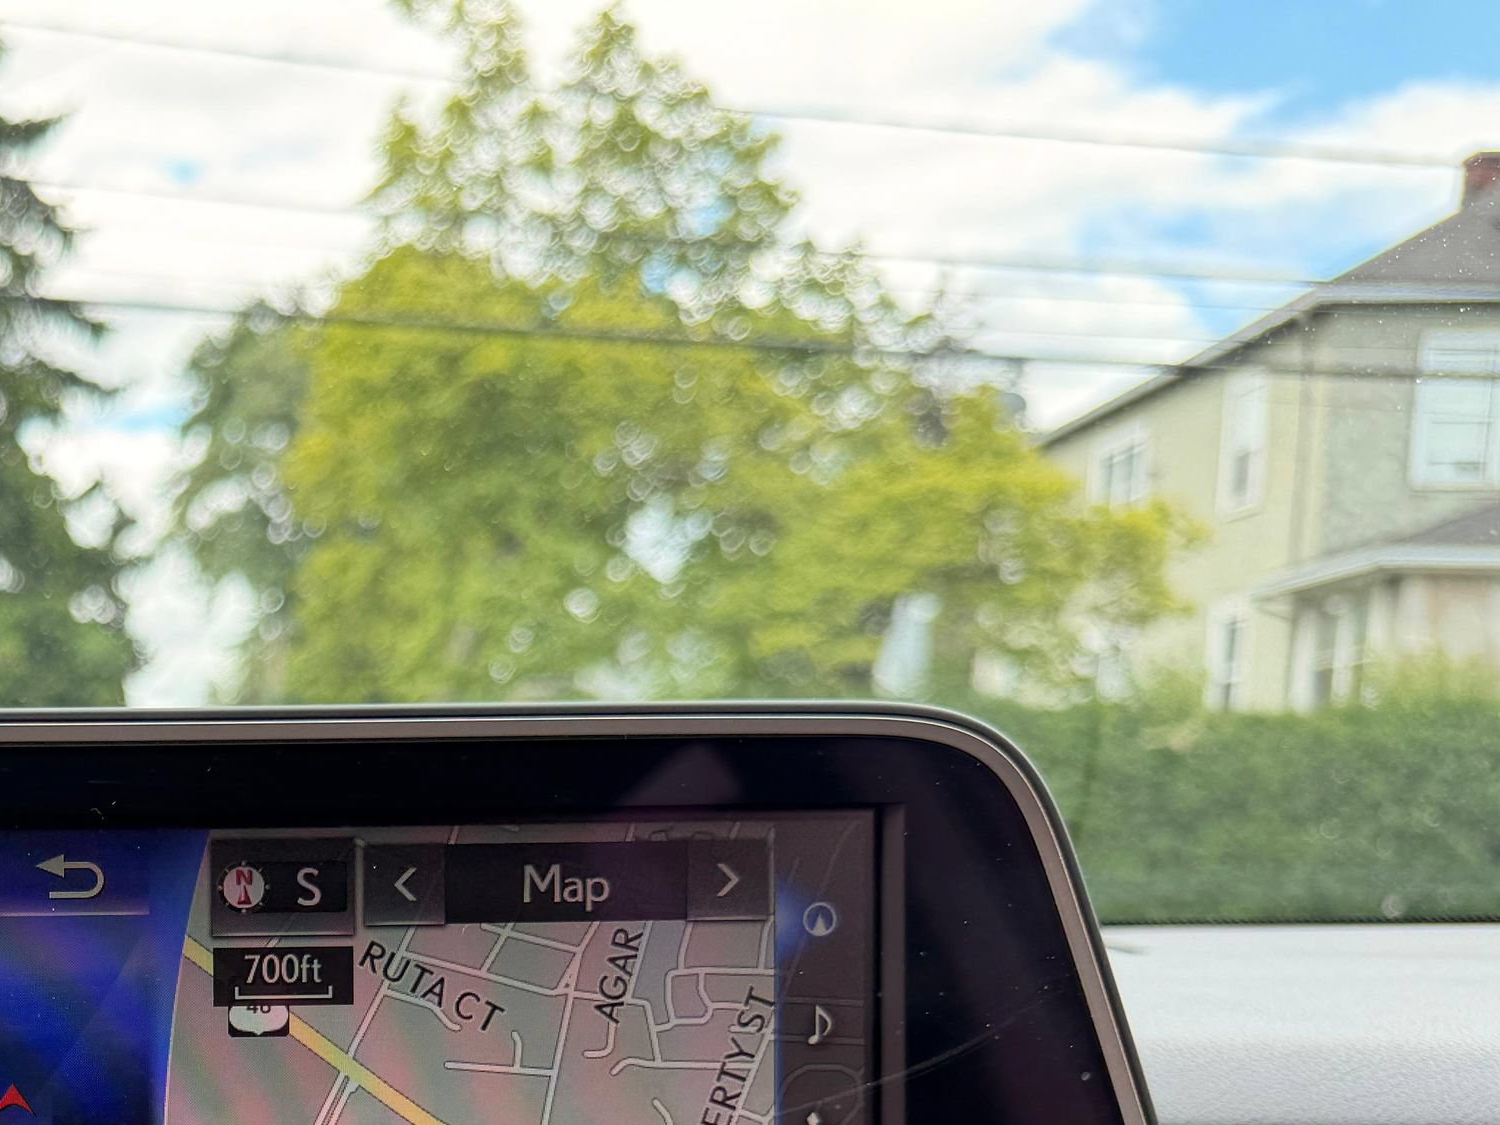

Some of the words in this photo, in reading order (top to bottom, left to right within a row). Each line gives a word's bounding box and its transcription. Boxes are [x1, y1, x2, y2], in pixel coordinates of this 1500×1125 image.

[296, 867, 322, 906] S
[522, 863, 611, 912] Map
[243, 954, 323, 985] 700ft
[358, 940, 446, 1009] RUTA
[453, 992, 506, 1033] CT
[594, 927, 644, 1024] AGAR
[739, 986, 775, 1032] ST
